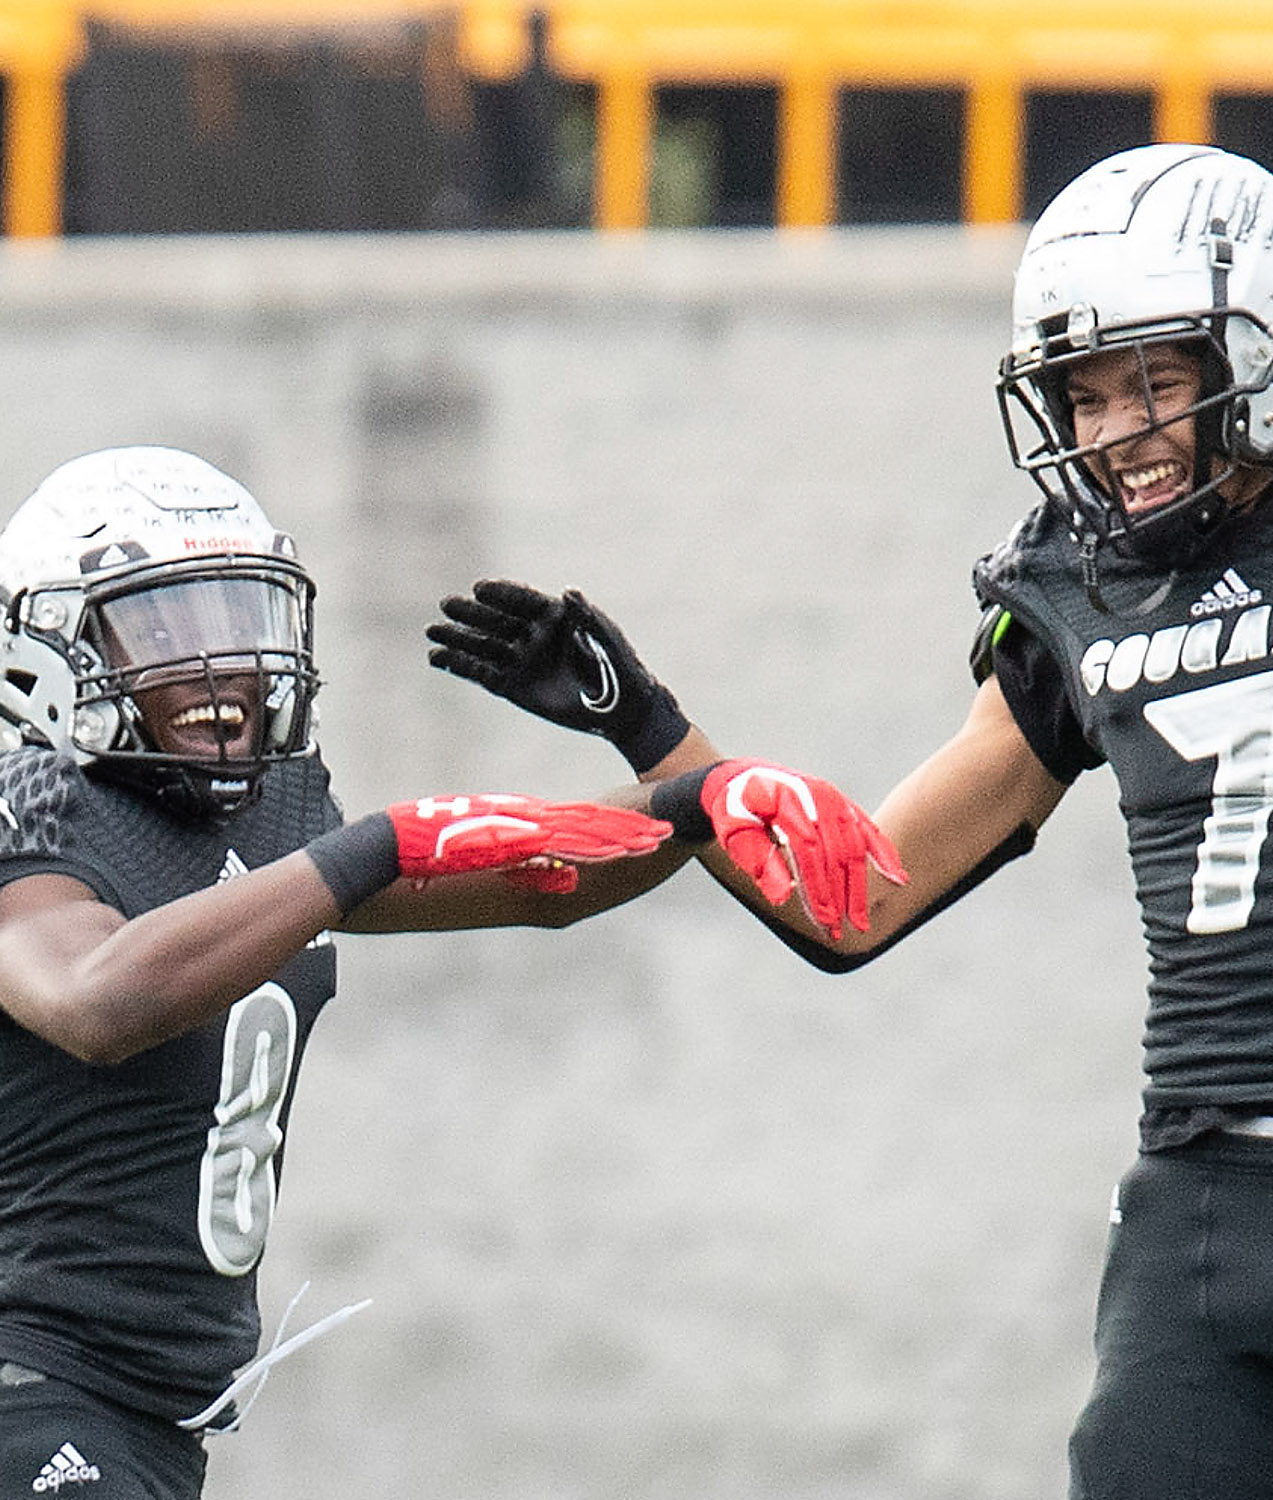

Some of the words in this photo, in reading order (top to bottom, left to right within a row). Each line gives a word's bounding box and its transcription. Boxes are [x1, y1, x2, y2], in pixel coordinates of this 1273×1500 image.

[1190, 588, 1263, 617] adidas
[197, 980, 297, 1276] 8
[32, 1464, 101, 1493] adidas
